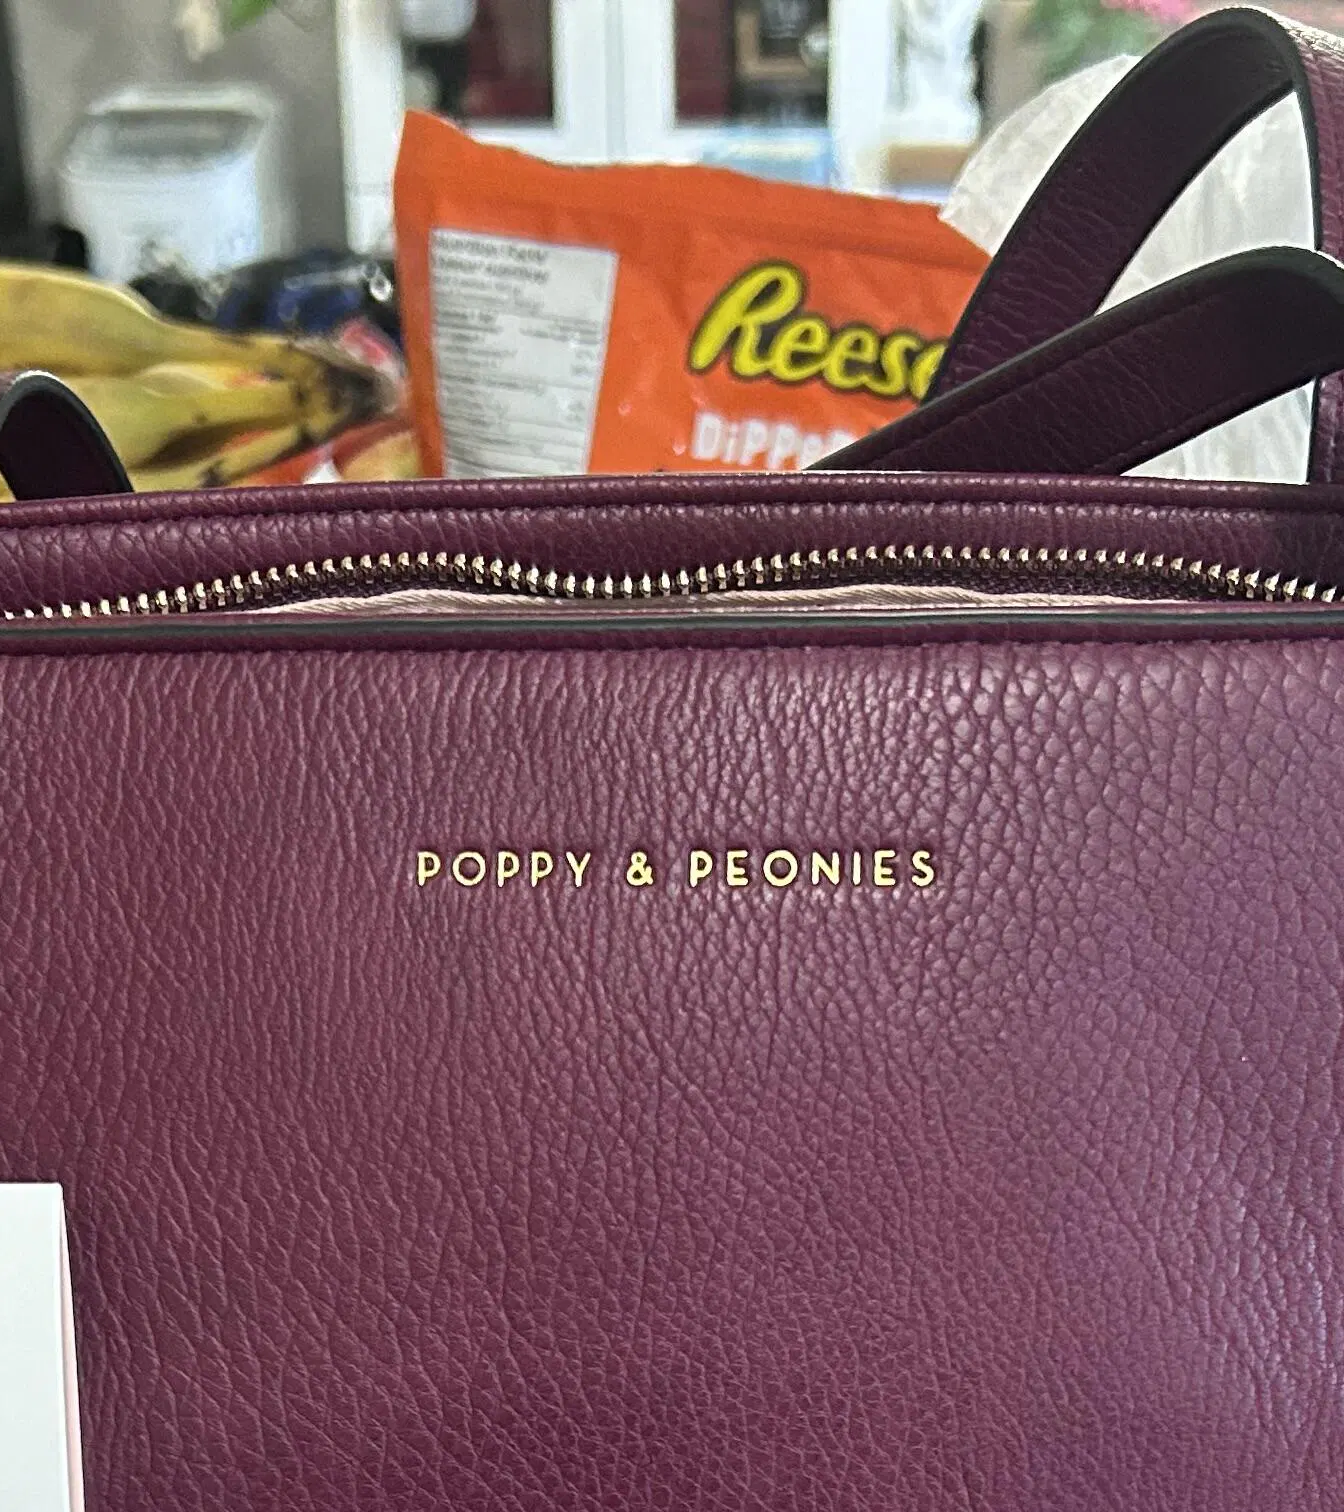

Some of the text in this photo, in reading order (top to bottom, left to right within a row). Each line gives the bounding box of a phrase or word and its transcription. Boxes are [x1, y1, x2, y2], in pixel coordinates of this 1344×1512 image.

[416, 848, 937, 888] POPPY & PEONIES
